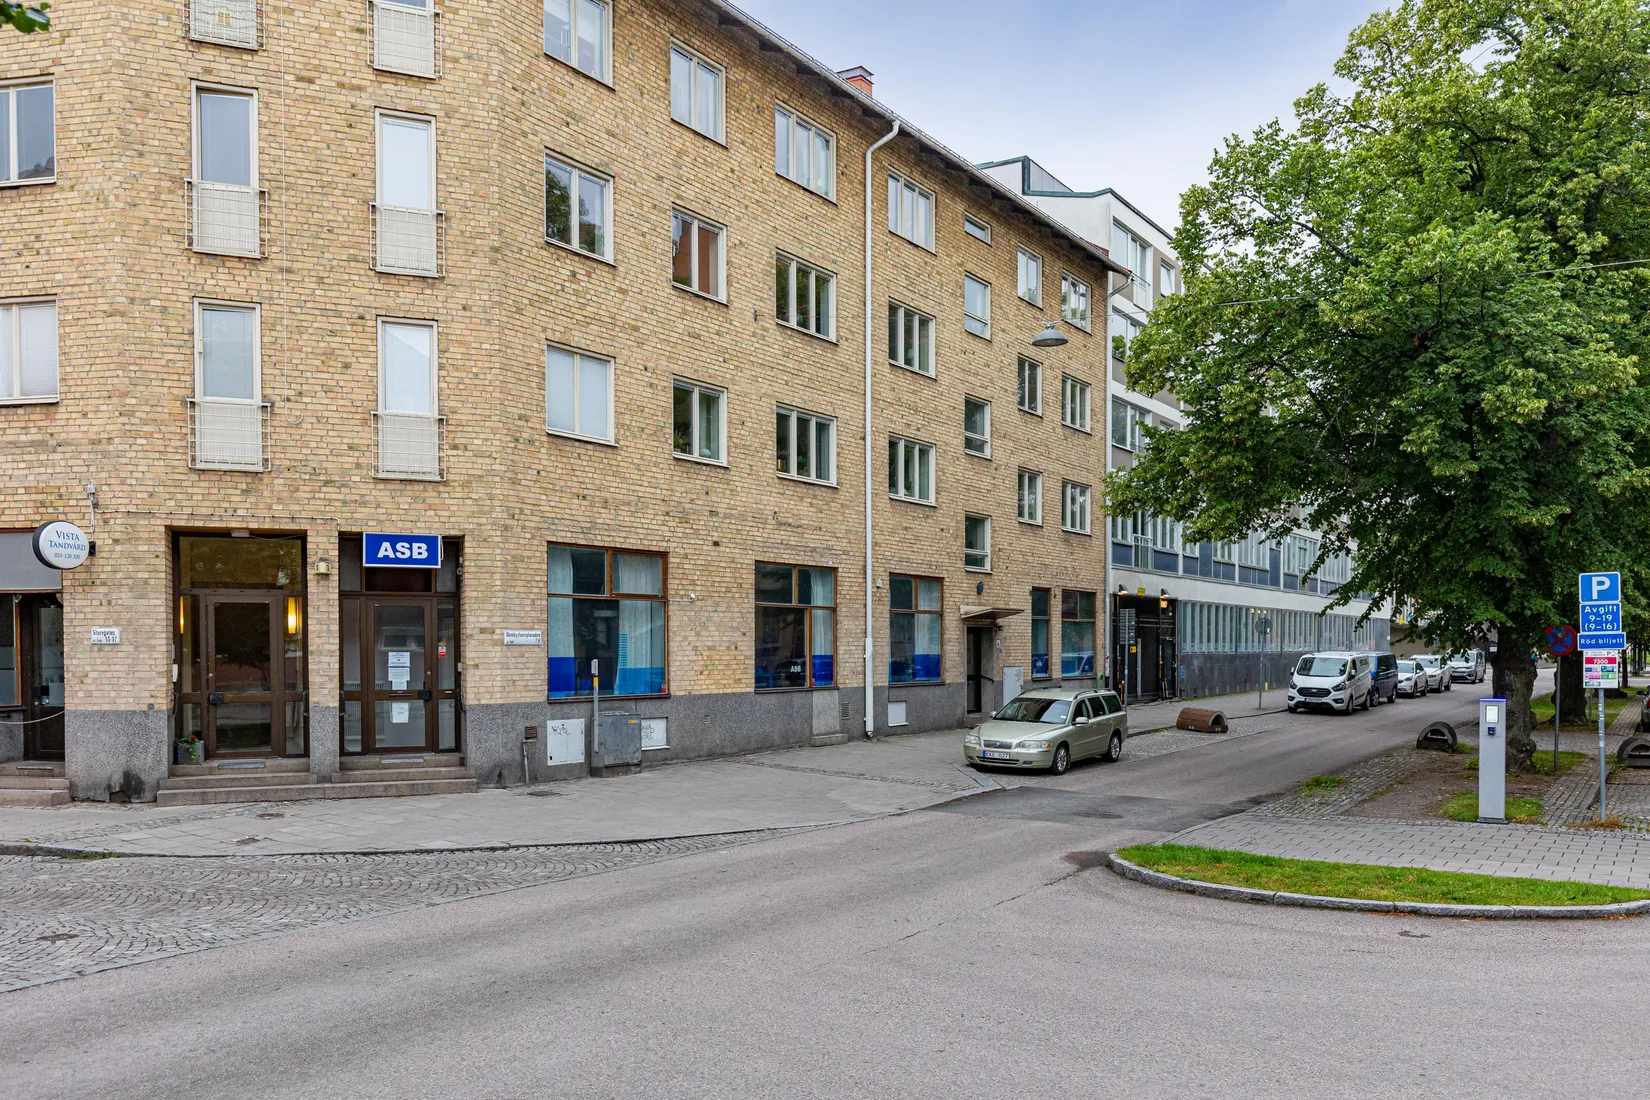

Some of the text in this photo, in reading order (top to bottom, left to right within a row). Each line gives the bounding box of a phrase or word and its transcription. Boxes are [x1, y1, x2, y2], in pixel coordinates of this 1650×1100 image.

[56, 530, 80, 541] VISTA
[49, 540, 86, 551] TANDVÅRD
[377, 542, 428, 559] ASB
[1591, 576, 1611, 600] P
[1585, 605, 1617, 614] Avgift
